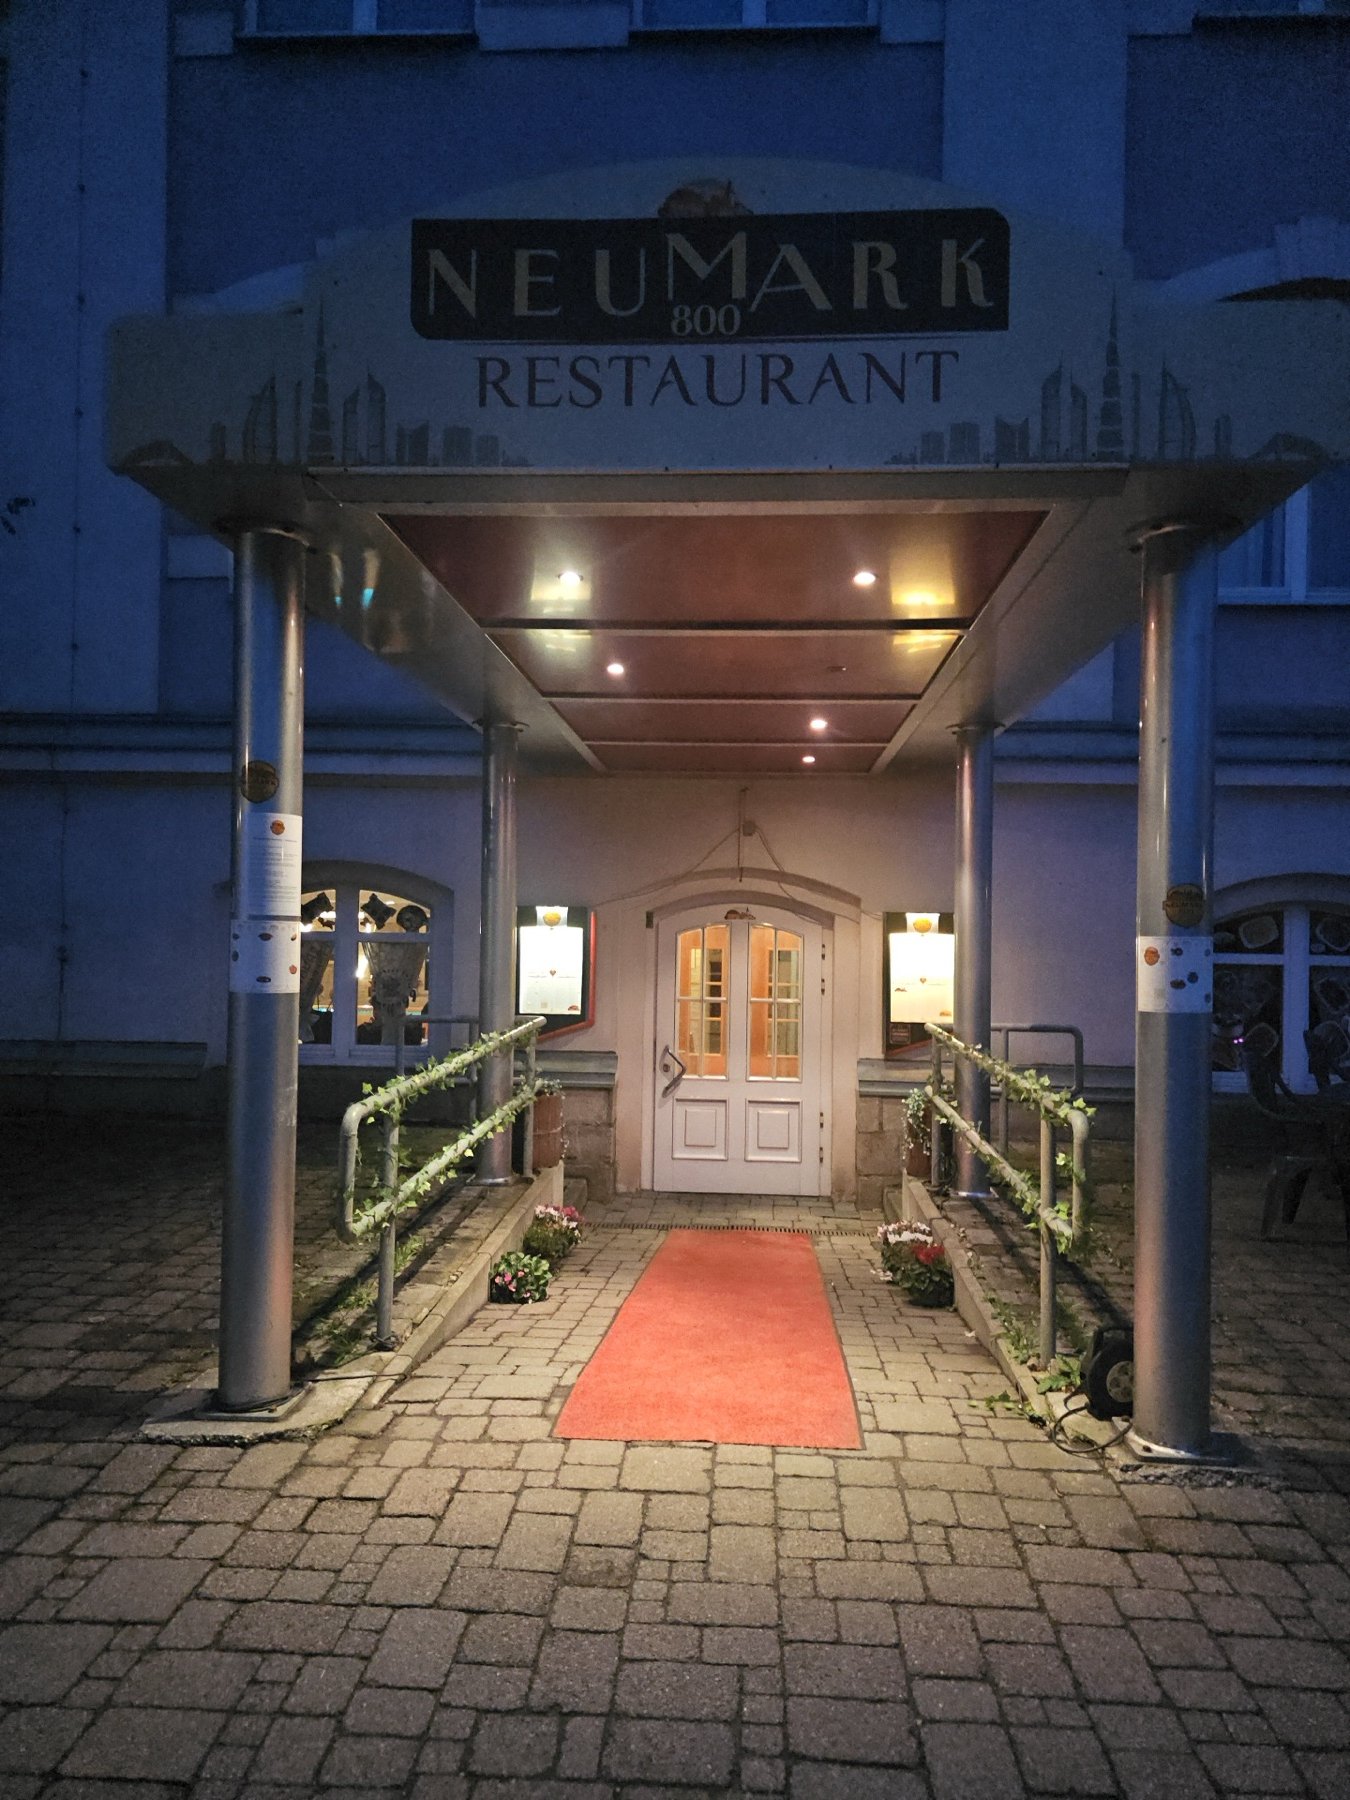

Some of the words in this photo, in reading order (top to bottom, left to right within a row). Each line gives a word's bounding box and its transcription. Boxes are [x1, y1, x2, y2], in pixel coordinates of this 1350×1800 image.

[427, 231, 994, 319] NEUMARK
[670, 304, 742, 337] 800
[476, 351, 959, 408] RESTAURANT
